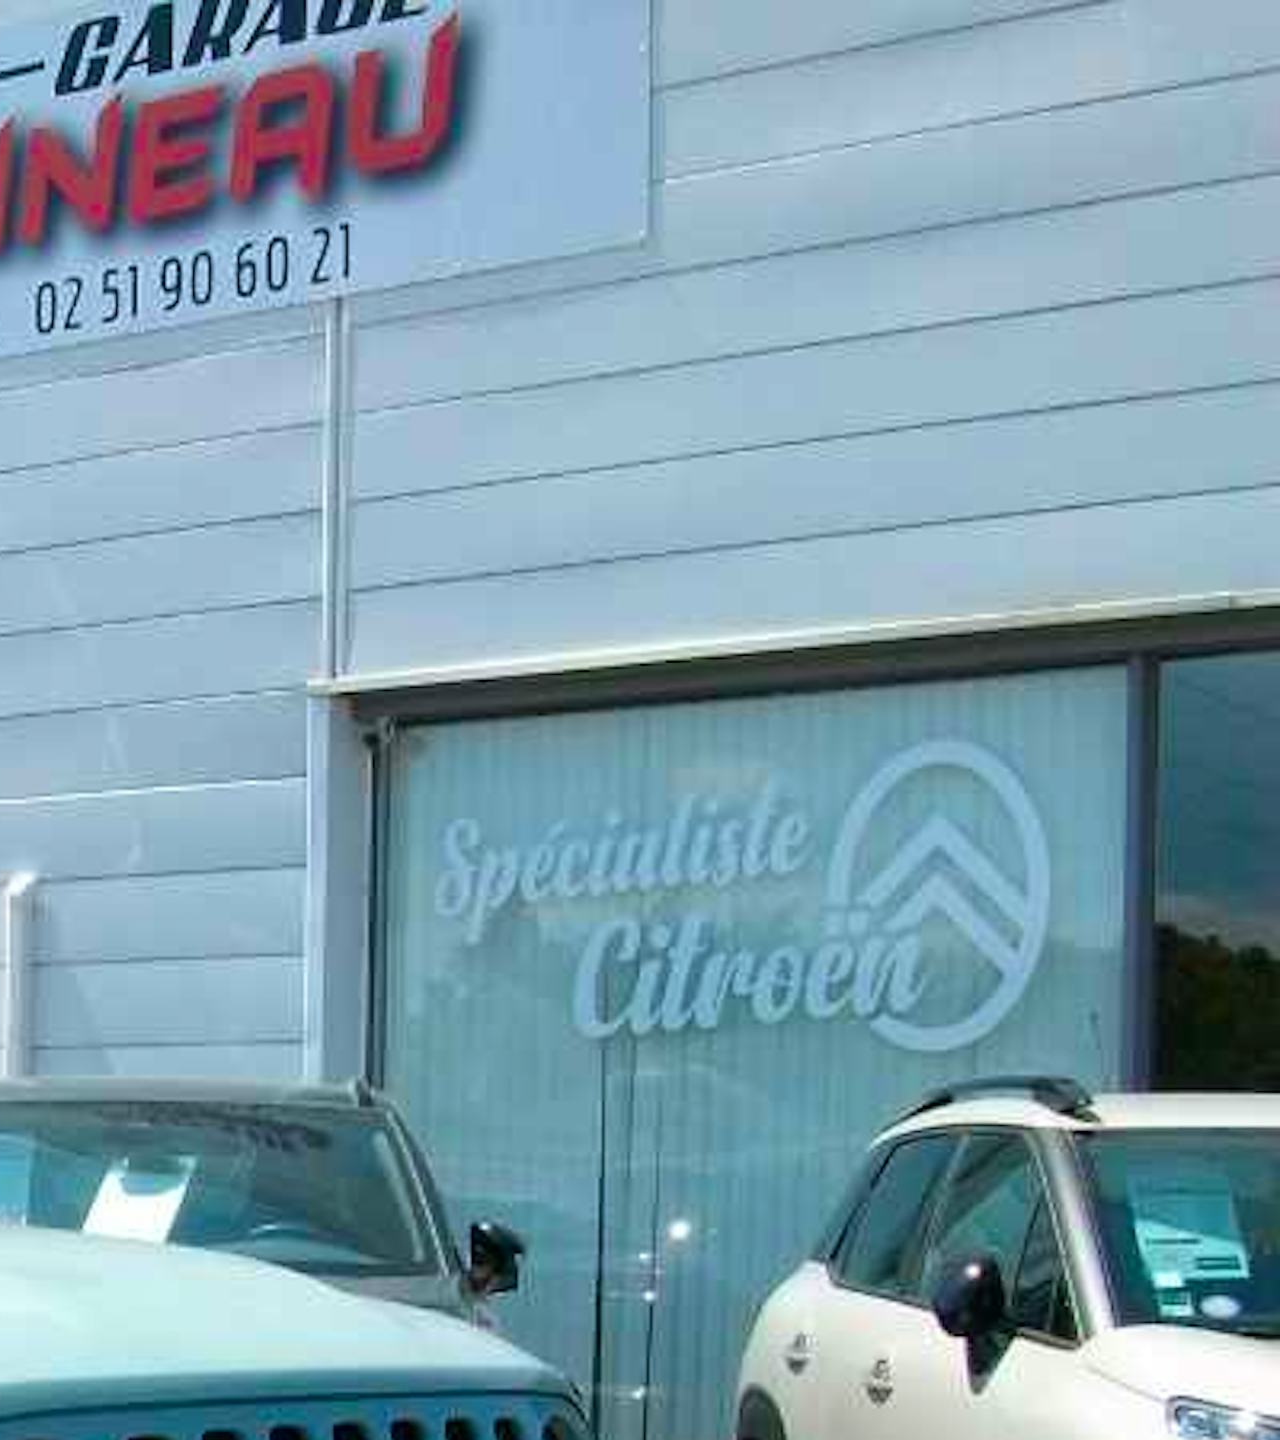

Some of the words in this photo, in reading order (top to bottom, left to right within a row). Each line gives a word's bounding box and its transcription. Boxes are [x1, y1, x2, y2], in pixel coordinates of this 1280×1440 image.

[54, 0, 428, 95] GARA
[35, 277, 83, 334] 02
[101, 265, 139, 323] 51
[160, 250, 213, 311] 90
[236, 235, 289, 298] 60
[310, 222, 350, 285] 21
[437, 783, 810, 944] Spécialiste
[573, 910, 926, 1040] Citroën
